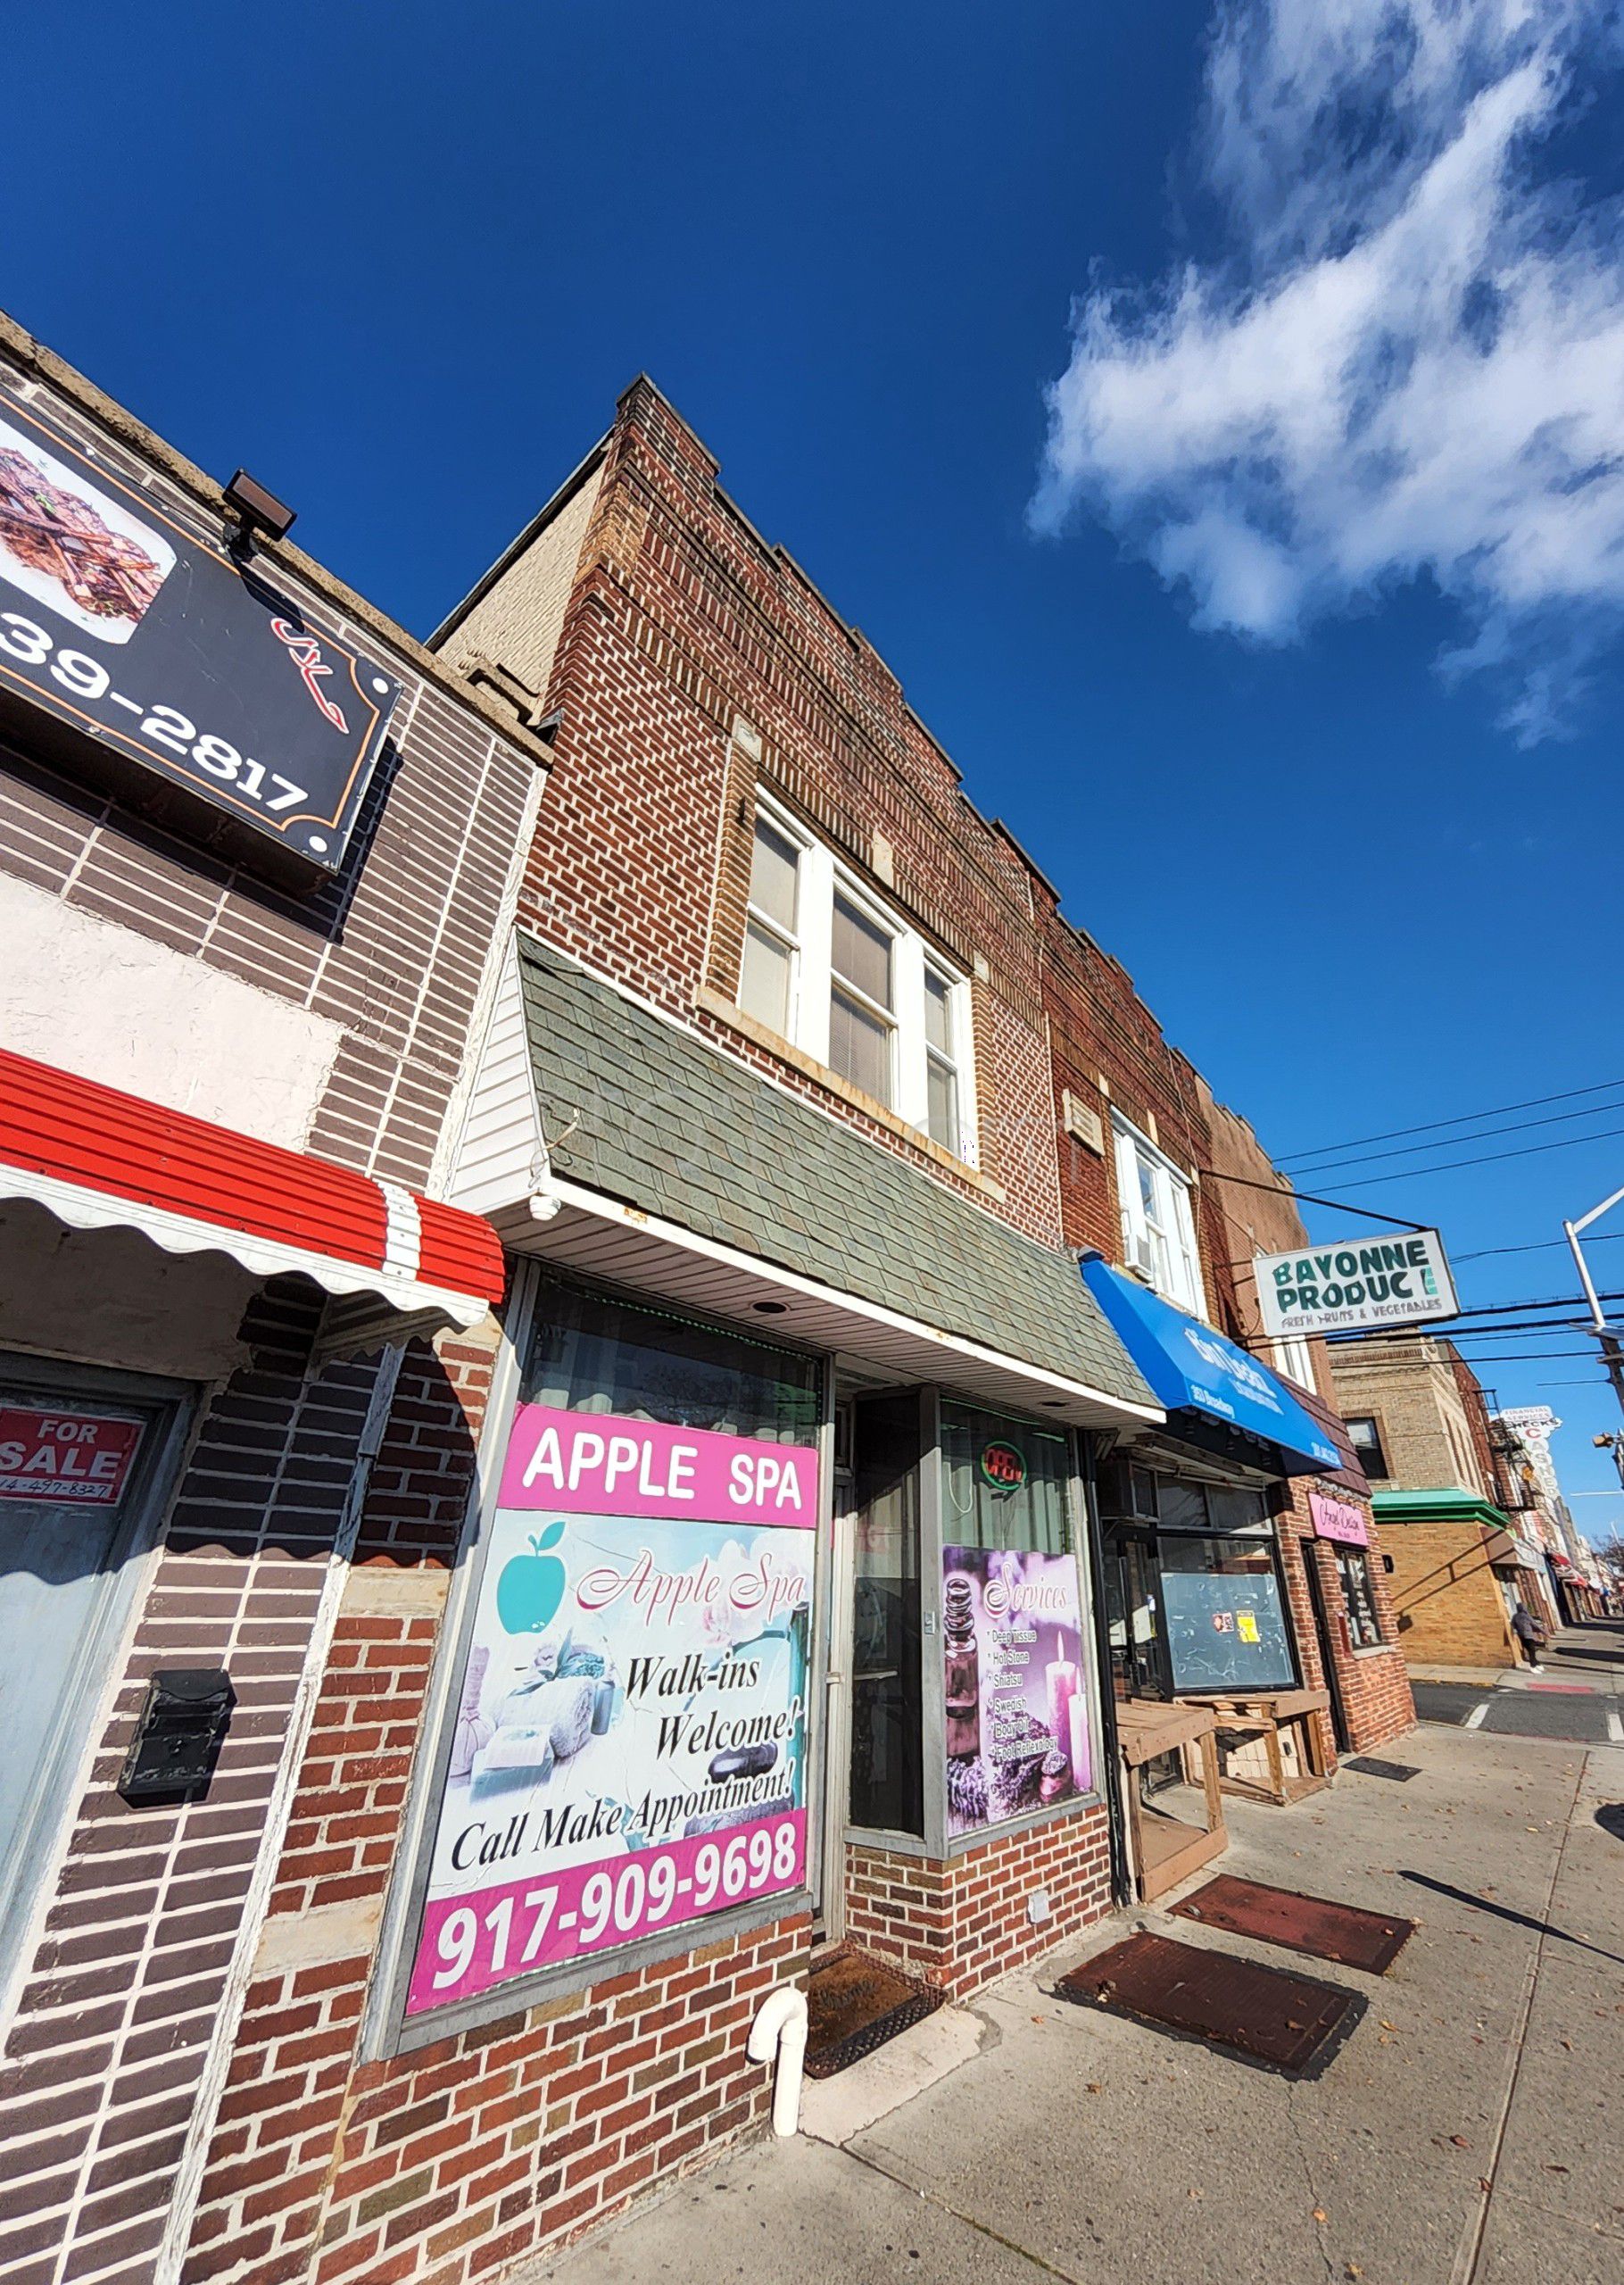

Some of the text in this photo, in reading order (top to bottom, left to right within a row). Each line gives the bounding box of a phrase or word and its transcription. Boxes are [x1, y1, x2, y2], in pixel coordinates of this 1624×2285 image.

[1272, 1239, 1429, 1287] BAYONNE
[1359, 1308, 1367, 1319] &
[37, 1419, 98, 1444] FOR
[0, 1441, 123, 1479] SALE
[522, 1426, 802, 1510] APPLE SPA
[576, 1549, 804, 1627] Apple Spa
[984, 1563, 1067, 1617] Services
[991, 1629, 1013, 1645] Deep
[626, 1651, 760, 1700] Walk-ins
[992, 1649, 1030, 1666] Hot Stone
[993, 1671, 1023, 1689] Shiatsu
[994, 1696, 1027, 1713] Swedish
[656, 1699, 799, 1761] Welcome!
[995, 1721, 1016, 1738] Body
[995, 1736, 1058, 1762] Foot Reflexology
[452, 1760, 795, 1871] Call Make Appointment!
[432, 1822, 797, 1990] 917-909-9698
